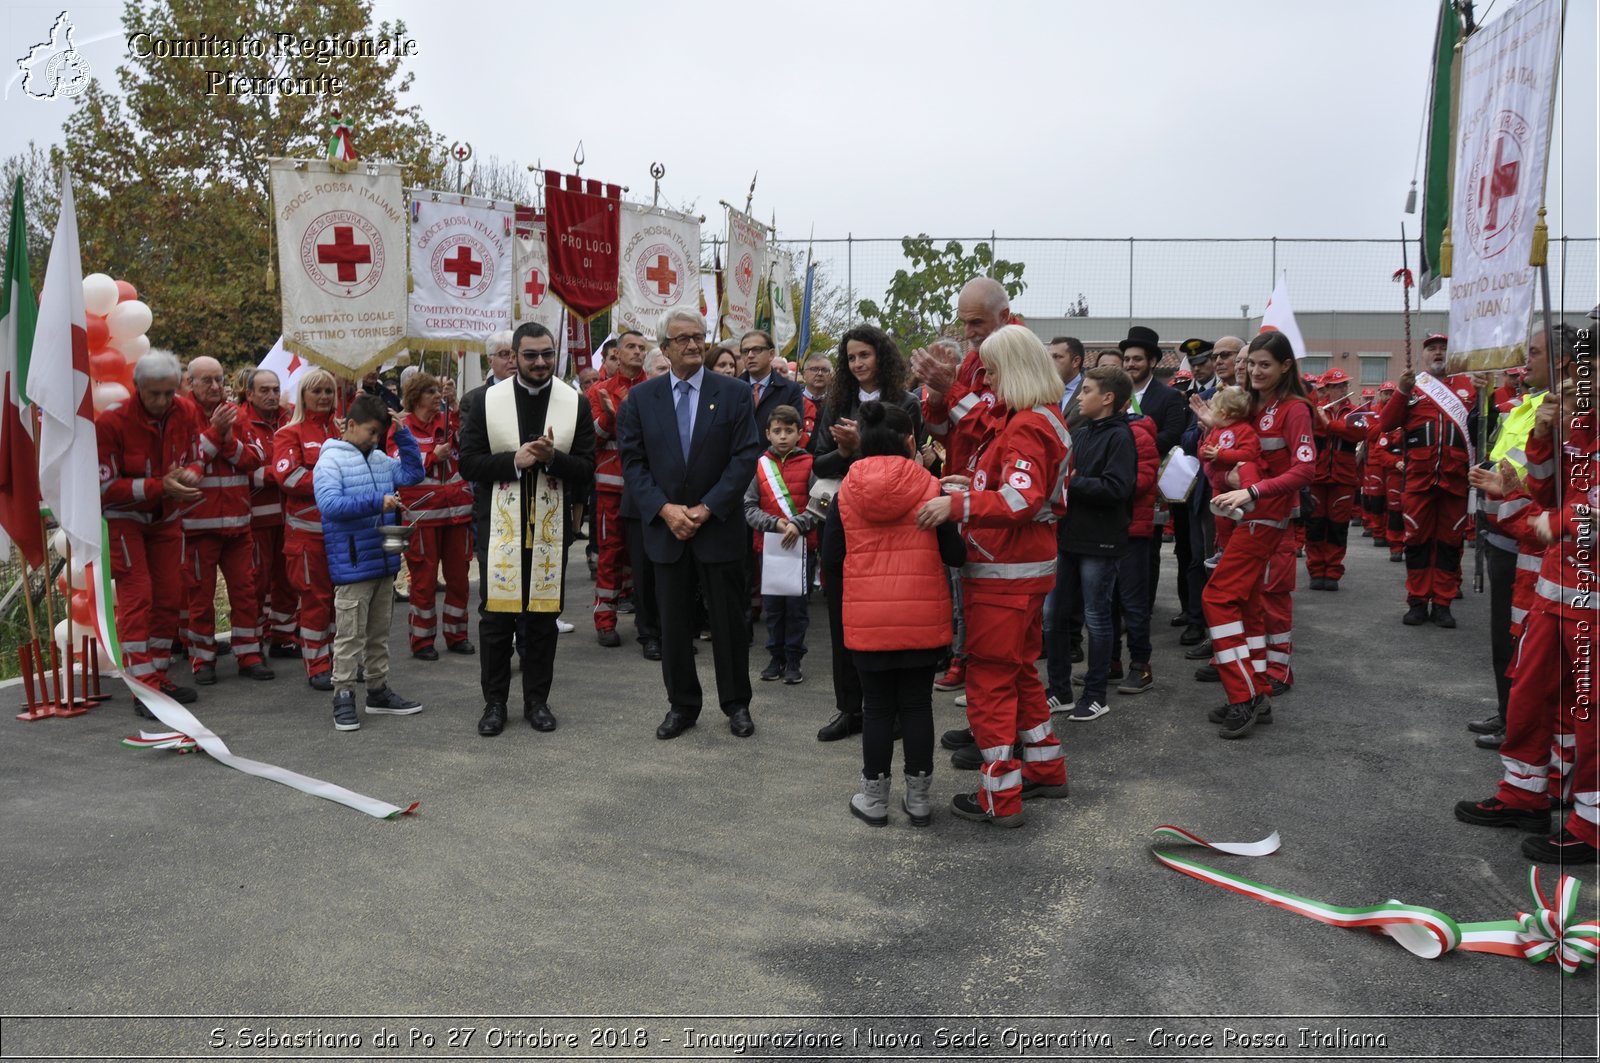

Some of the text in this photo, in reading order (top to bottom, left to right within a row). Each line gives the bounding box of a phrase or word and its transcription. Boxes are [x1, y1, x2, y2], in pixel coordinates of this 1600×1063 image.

[281, 182, 401, 224] CROCE ROSSA ITALIANA
[418, 216, 505, 258] CROCE ROSSA ITALIANA
[560, 234, 582, 249] PRO
[586, 240, 612, 255] LOCO
[624, 232, 644, 262] CROCE
[643, 226, 672, 237] ROSSA
[672, 233, 697, 277] ITALIANA
[583, 257, 592, 268] DI
[300, 311, 395, 324] COMITATO LOCALE
[414, 304, 463, 315] COMITATO
[464, 308, 495, 318] LOCALE
[497, 310, 507, 318] DI
[425, 318, 497, 332] CRESCENTINO
[293, 326, 403, 341] SETTIMO TORINESE
